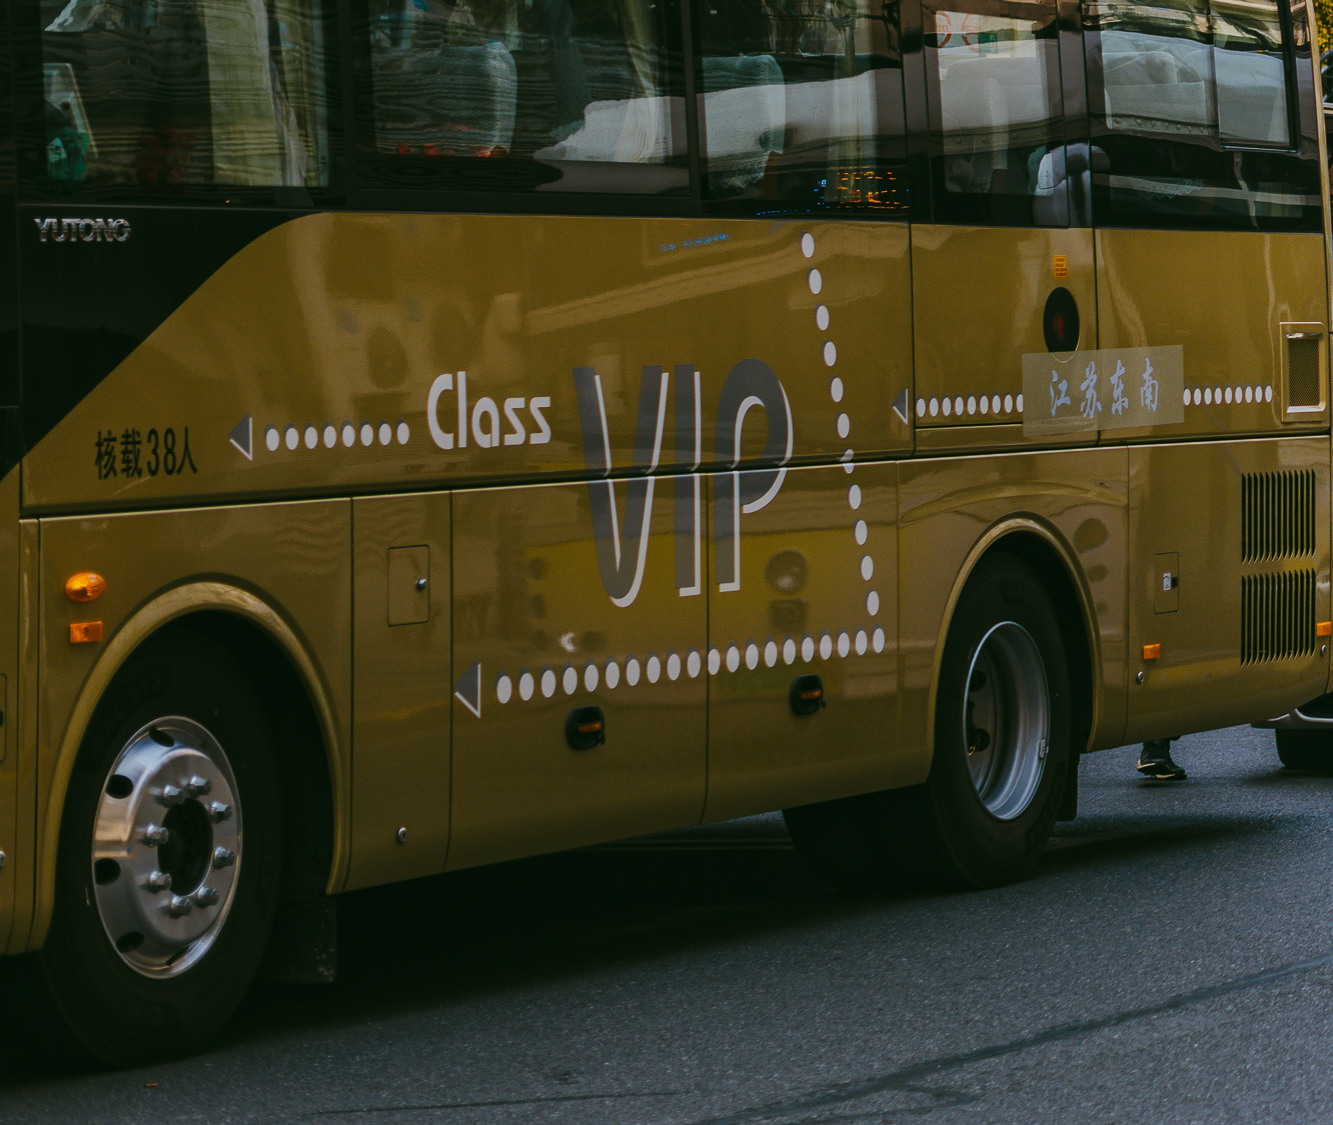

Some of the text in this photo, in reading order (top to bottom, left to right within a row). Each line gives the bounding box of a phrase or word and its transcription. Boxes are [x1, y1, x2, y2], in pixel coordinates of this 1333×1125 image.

[34, 218, 132, 242] YUTONG
[1050, 357, 1159, 419] 江苏东南
[95, 426, 198, 480] 核载38人
[427, 358, 794, 608] Class VIP
